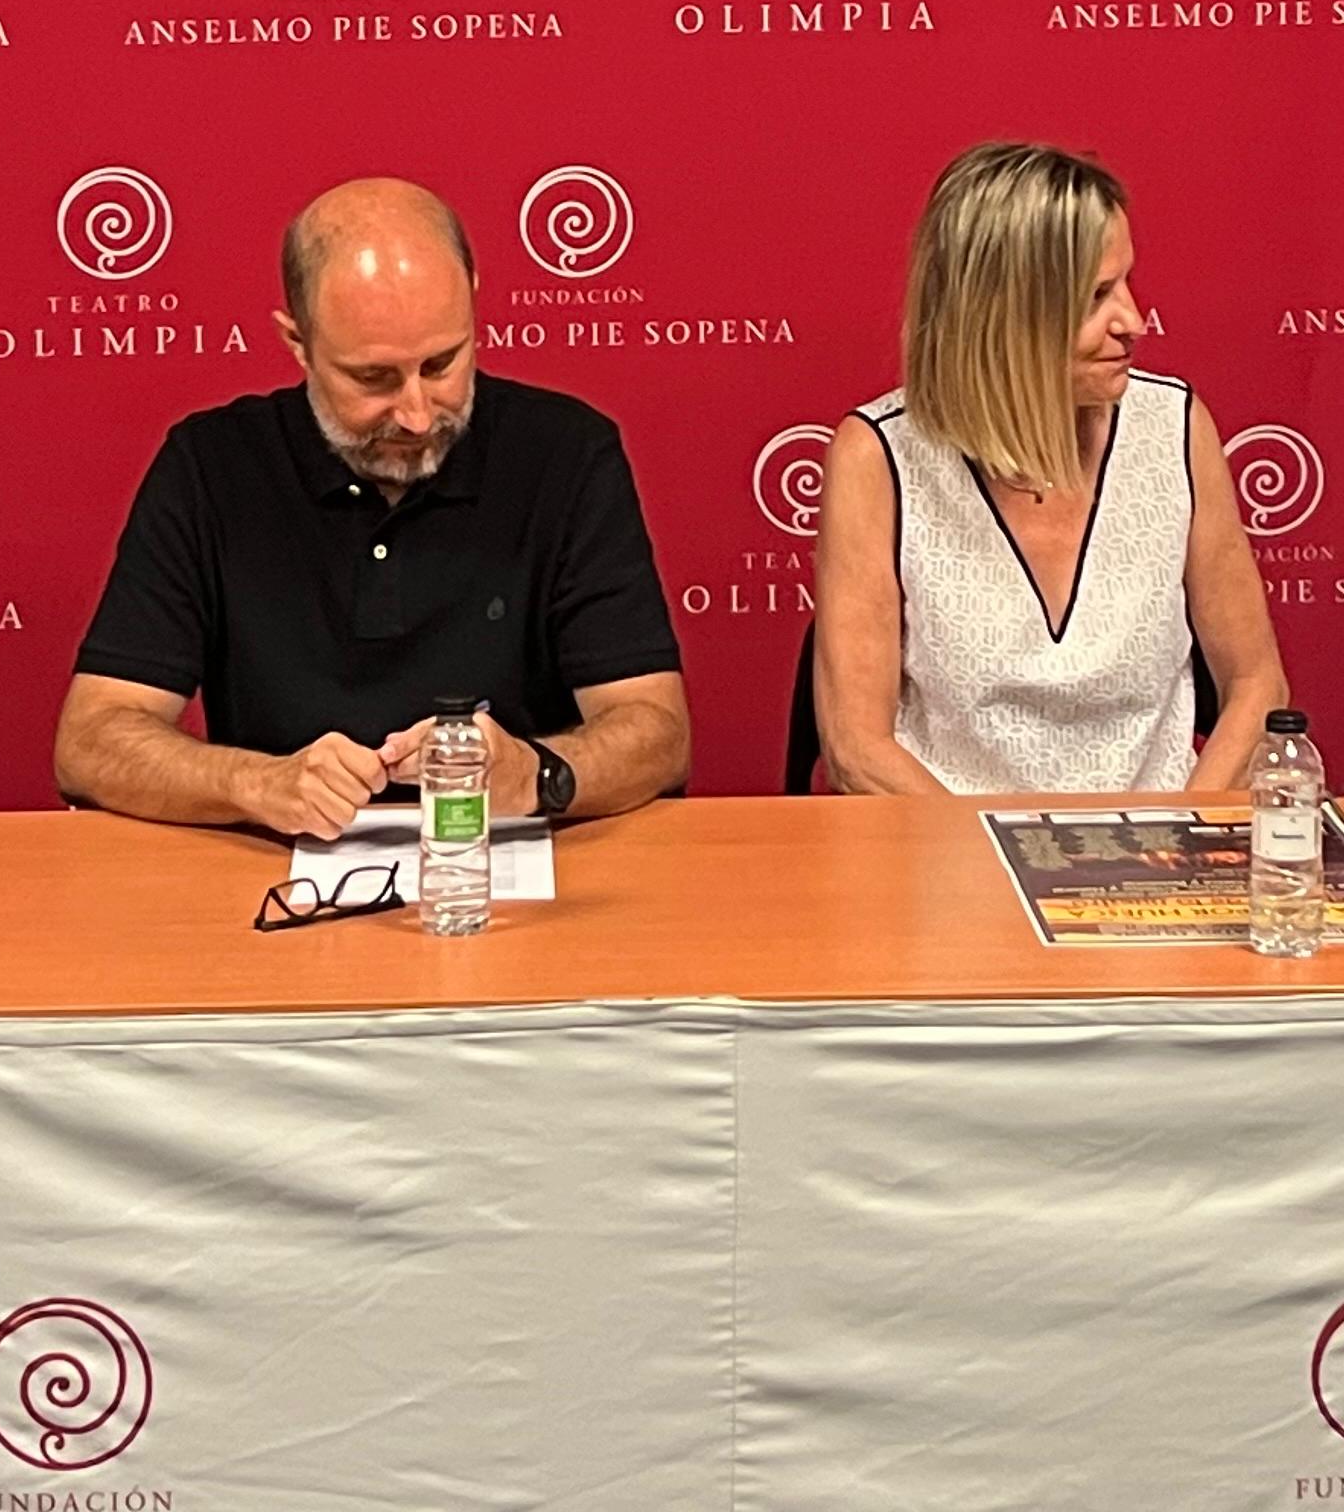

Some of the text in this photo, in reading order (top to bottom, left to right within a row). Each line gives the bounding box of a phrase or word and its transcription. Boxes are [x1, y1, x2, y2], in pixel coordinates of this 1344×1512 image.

[124, 13, 563, 46] ANSELMO PIE SOPENA
[674, 1, 934, 34] OLIMPIA
[1047, 2, 1234, 30] ANSELMO
[1255, 0, 1313, 27] PIE
[47, 293, 179, 314] TEATRO
[510, 285, 644, 306] FUNDACIÓN
[567, 321, 626, 348] PIE
[644, 318, 795, 346] SOPENA
[742, 551, 806, 570] TEA
